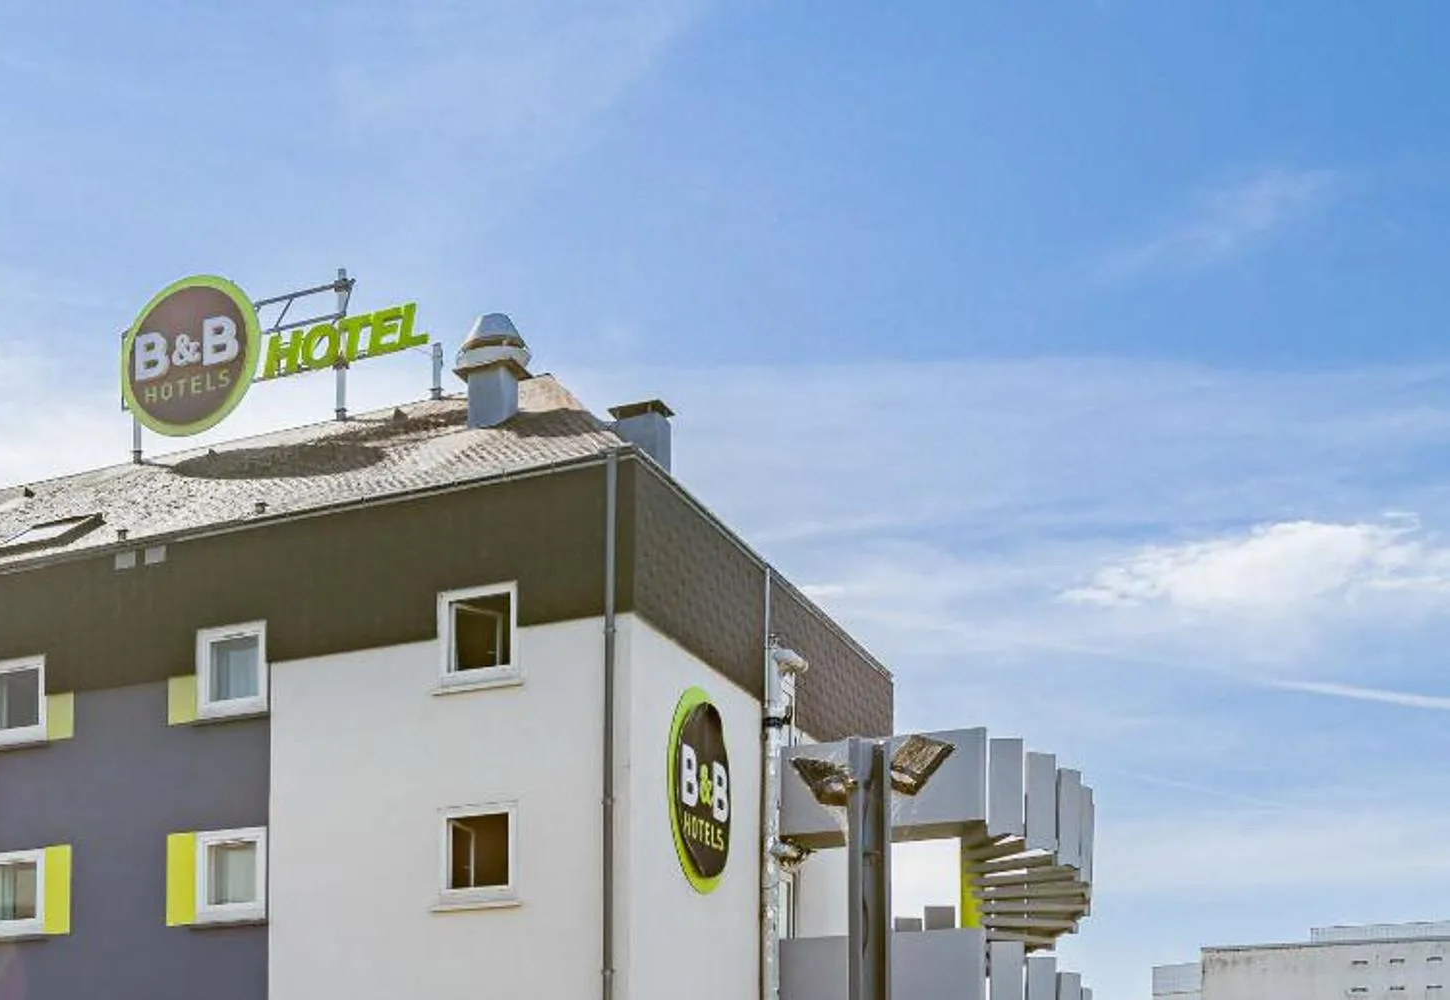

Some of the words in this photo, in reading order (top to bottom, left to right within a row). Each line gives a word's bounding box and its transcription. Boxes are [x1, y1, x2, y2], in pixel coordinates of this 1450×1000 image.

[134, 315, 239, 382] B&B
[263, 303, 430, 379] HOTEL
[144, 371, 231, 404] HOTELS
[681, 743, 728, 823] B&B
[683, 811, 724, 851] HOTELS
